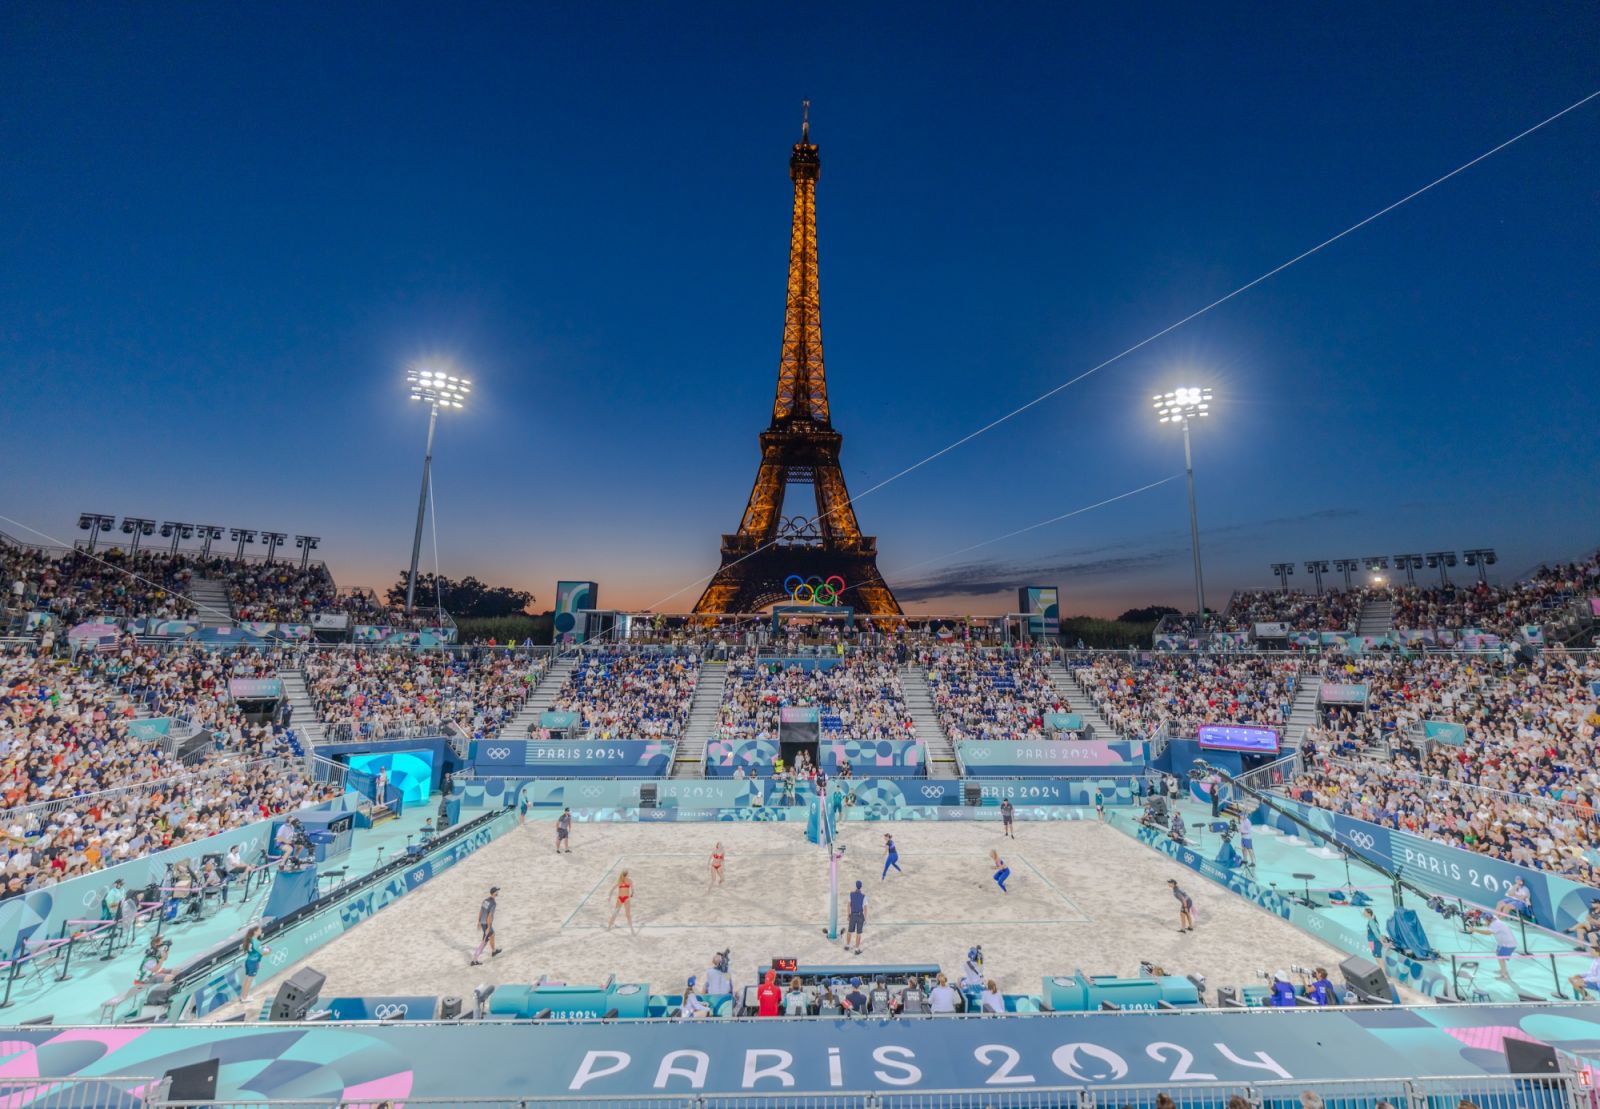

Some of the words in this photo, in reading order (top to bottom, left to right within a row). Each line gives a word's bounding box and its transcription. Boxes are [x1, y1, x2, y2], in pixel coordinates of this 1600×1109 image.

[586, 748, 625, 759] 2024
[1062, 748, 1098, 759] 2024
[632, 786, 677, 798] PIS
[683, 786, 724, 798] 2024
[981, 786, 1015, 798] ARIS
[1020, 786, 1060, 798] 2024
[1468, 869, 1514, 897] 202
[569, 1010, 597, 1019] 2024
[974, 1042, 1294, 1084] 2024
